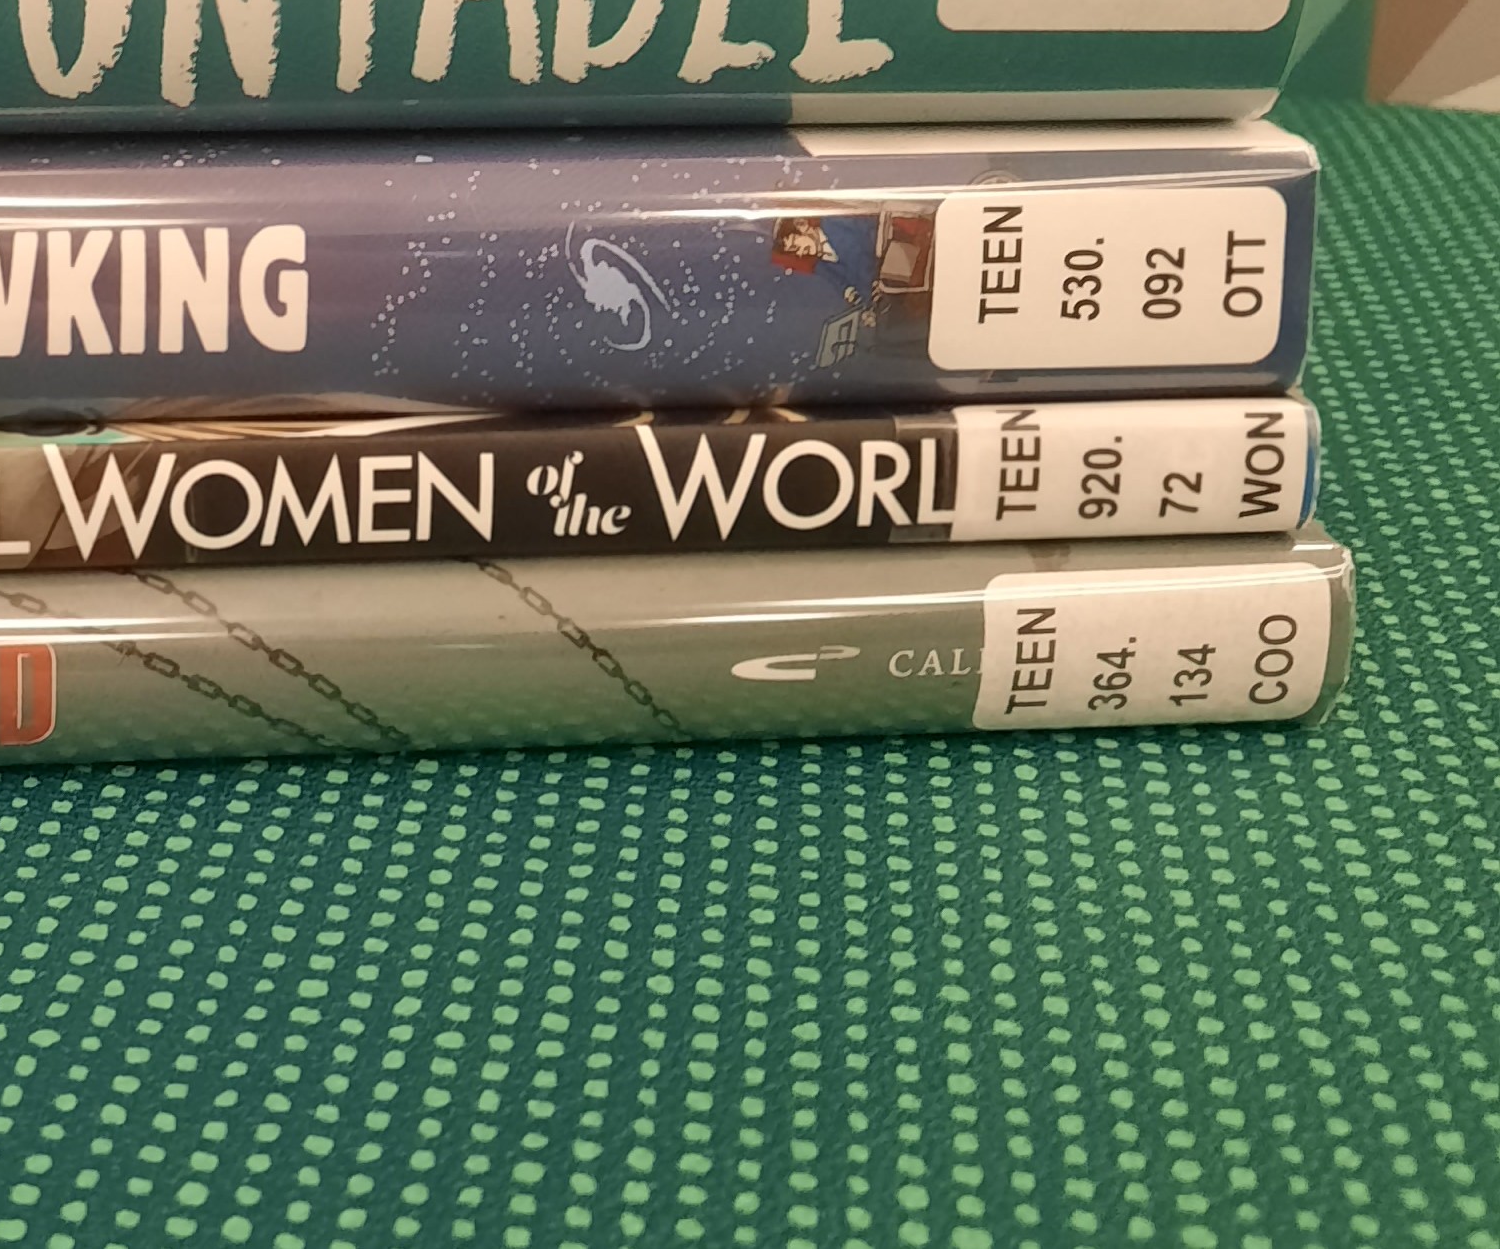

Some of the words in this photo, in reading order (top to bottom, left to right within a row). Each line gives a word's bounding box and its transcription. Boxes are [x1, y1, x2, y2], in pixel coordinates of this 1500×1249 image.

[977, 205, 1024, 325] TEEN
[1060, 237, 1105, 322] 530.
[1142, 246, 1186, 320] 092
[1222, 230, 1267, 318] OTT
[42, 442, 496, 562] WOMEN
[526, 448, 584, 508] of
[635, 423, 956, 542] WORL
[995, 408, 1041, 521] TEEN
[1078, 435, 1123, 520] 920.
[1159, 471, 1203, 518] 72
[1238, 411, 1286, 519] WON
[553, 492, 632, 536] the
[1004, 606, 1058, 715] TEEN
[1087, 635, 1137, 712] 364.
[1169, 642, 1218, 708] 134
[1247, 613, 1299, 706] COO
